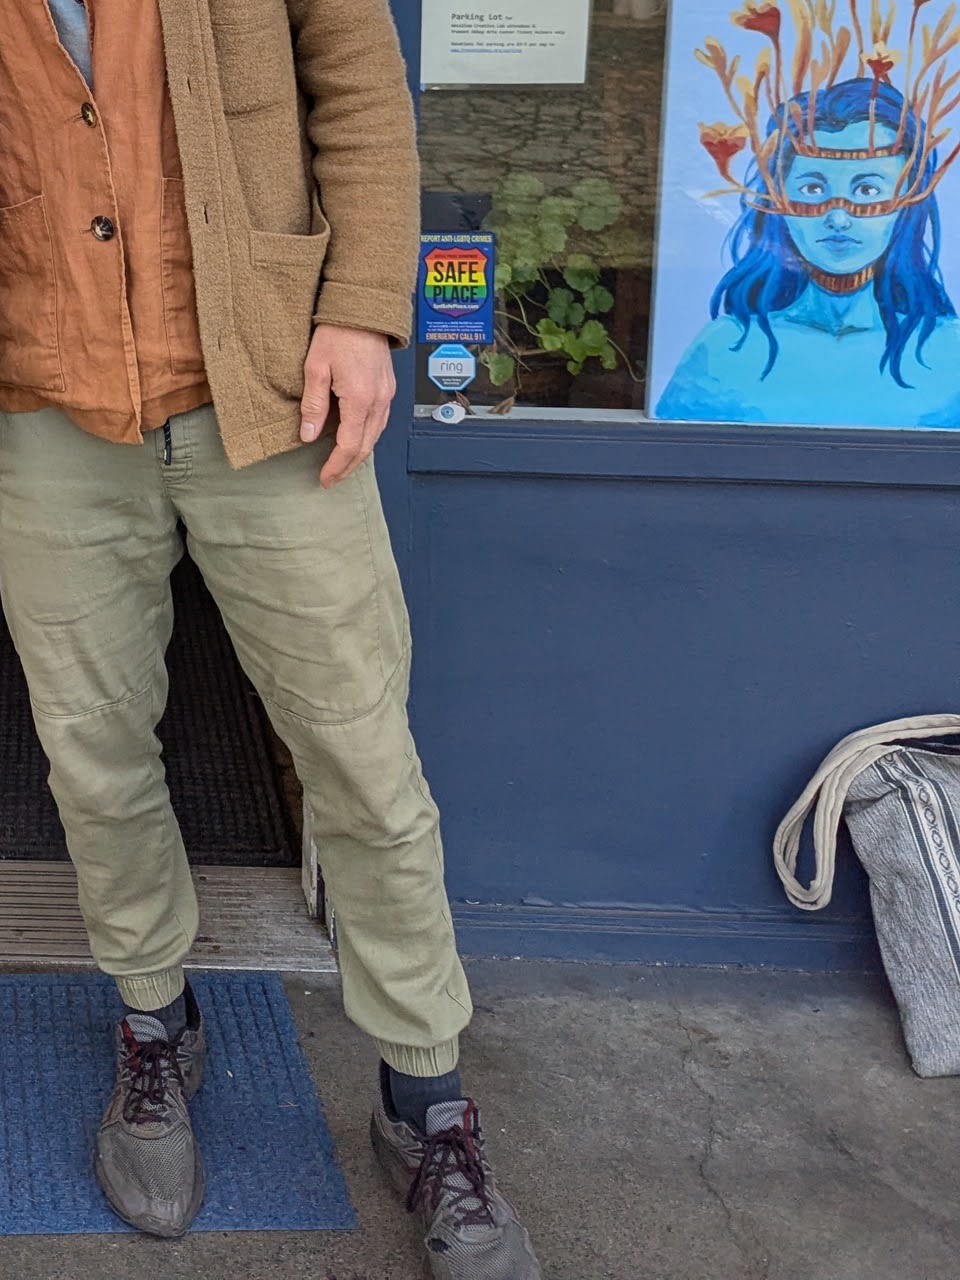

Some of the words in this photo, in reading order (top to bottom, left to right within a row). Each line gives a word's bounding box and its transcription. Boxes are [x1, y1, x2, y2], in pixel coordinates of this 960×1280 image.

[451, 13, 485, 22] Parking
[421, 235, 440, 243] REPORT
[441, 235, 470, 243] ANTI-LGBTQ
[433, 261, 478, 283] SAFE
[433, 286, 478, 303] PLACE
[426, 333, 458, 341] EMERGENCY
[460, 333, 473, 341] CALL
[474, 333, 486, 341] 911
[440, 361, 463, 374] ring
